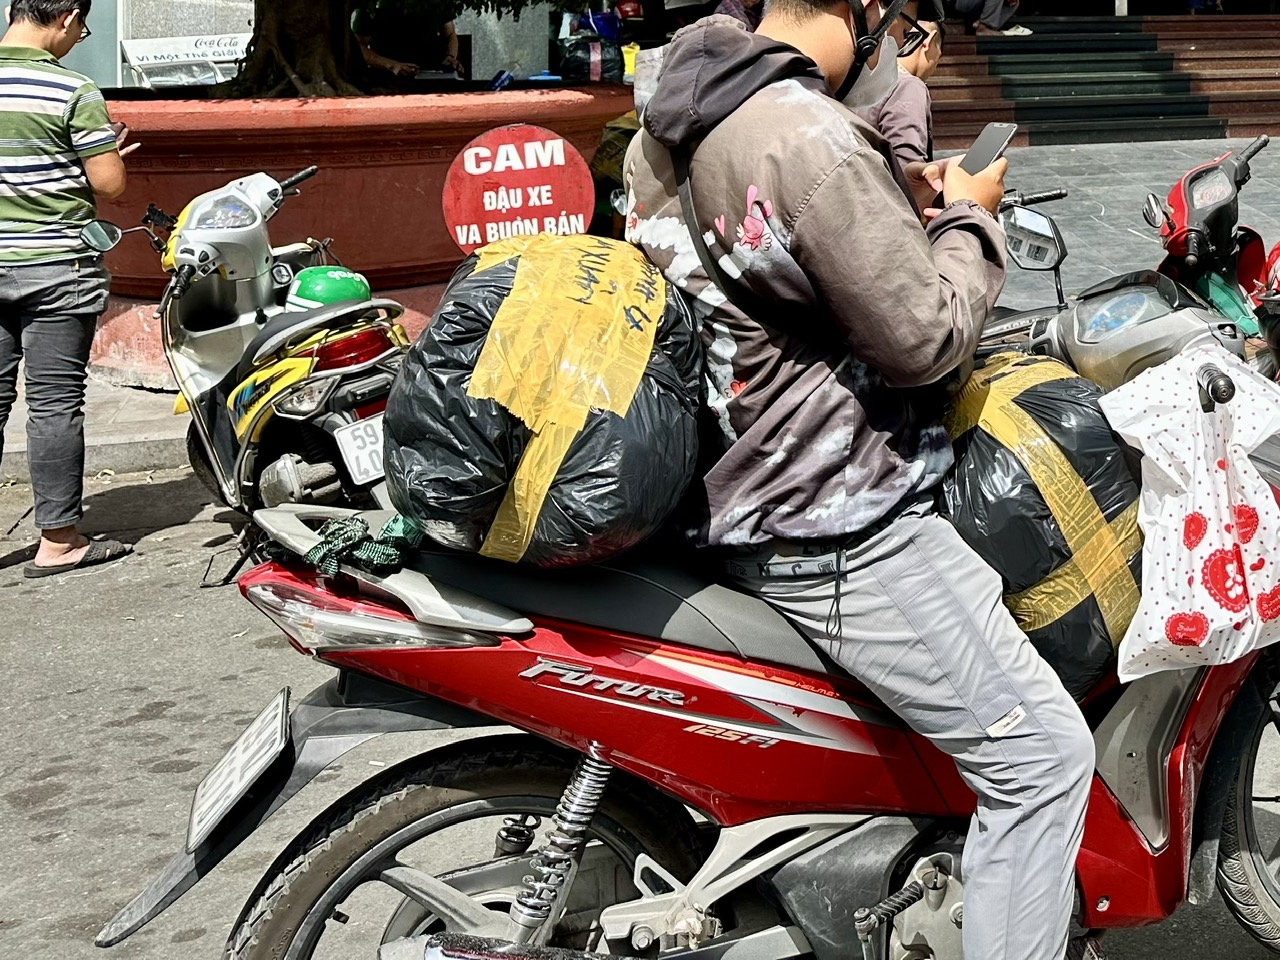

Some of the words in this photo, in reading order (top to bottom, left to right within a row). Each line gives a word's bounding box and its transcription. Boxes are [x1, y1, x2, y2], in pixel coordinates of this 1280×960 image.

[483, 186, 523, 214] ĐẬU
[527, 185, 554, 207] XE
[543, 210, 586, 236] BÁN
[682, 724, 749, 742] 125
